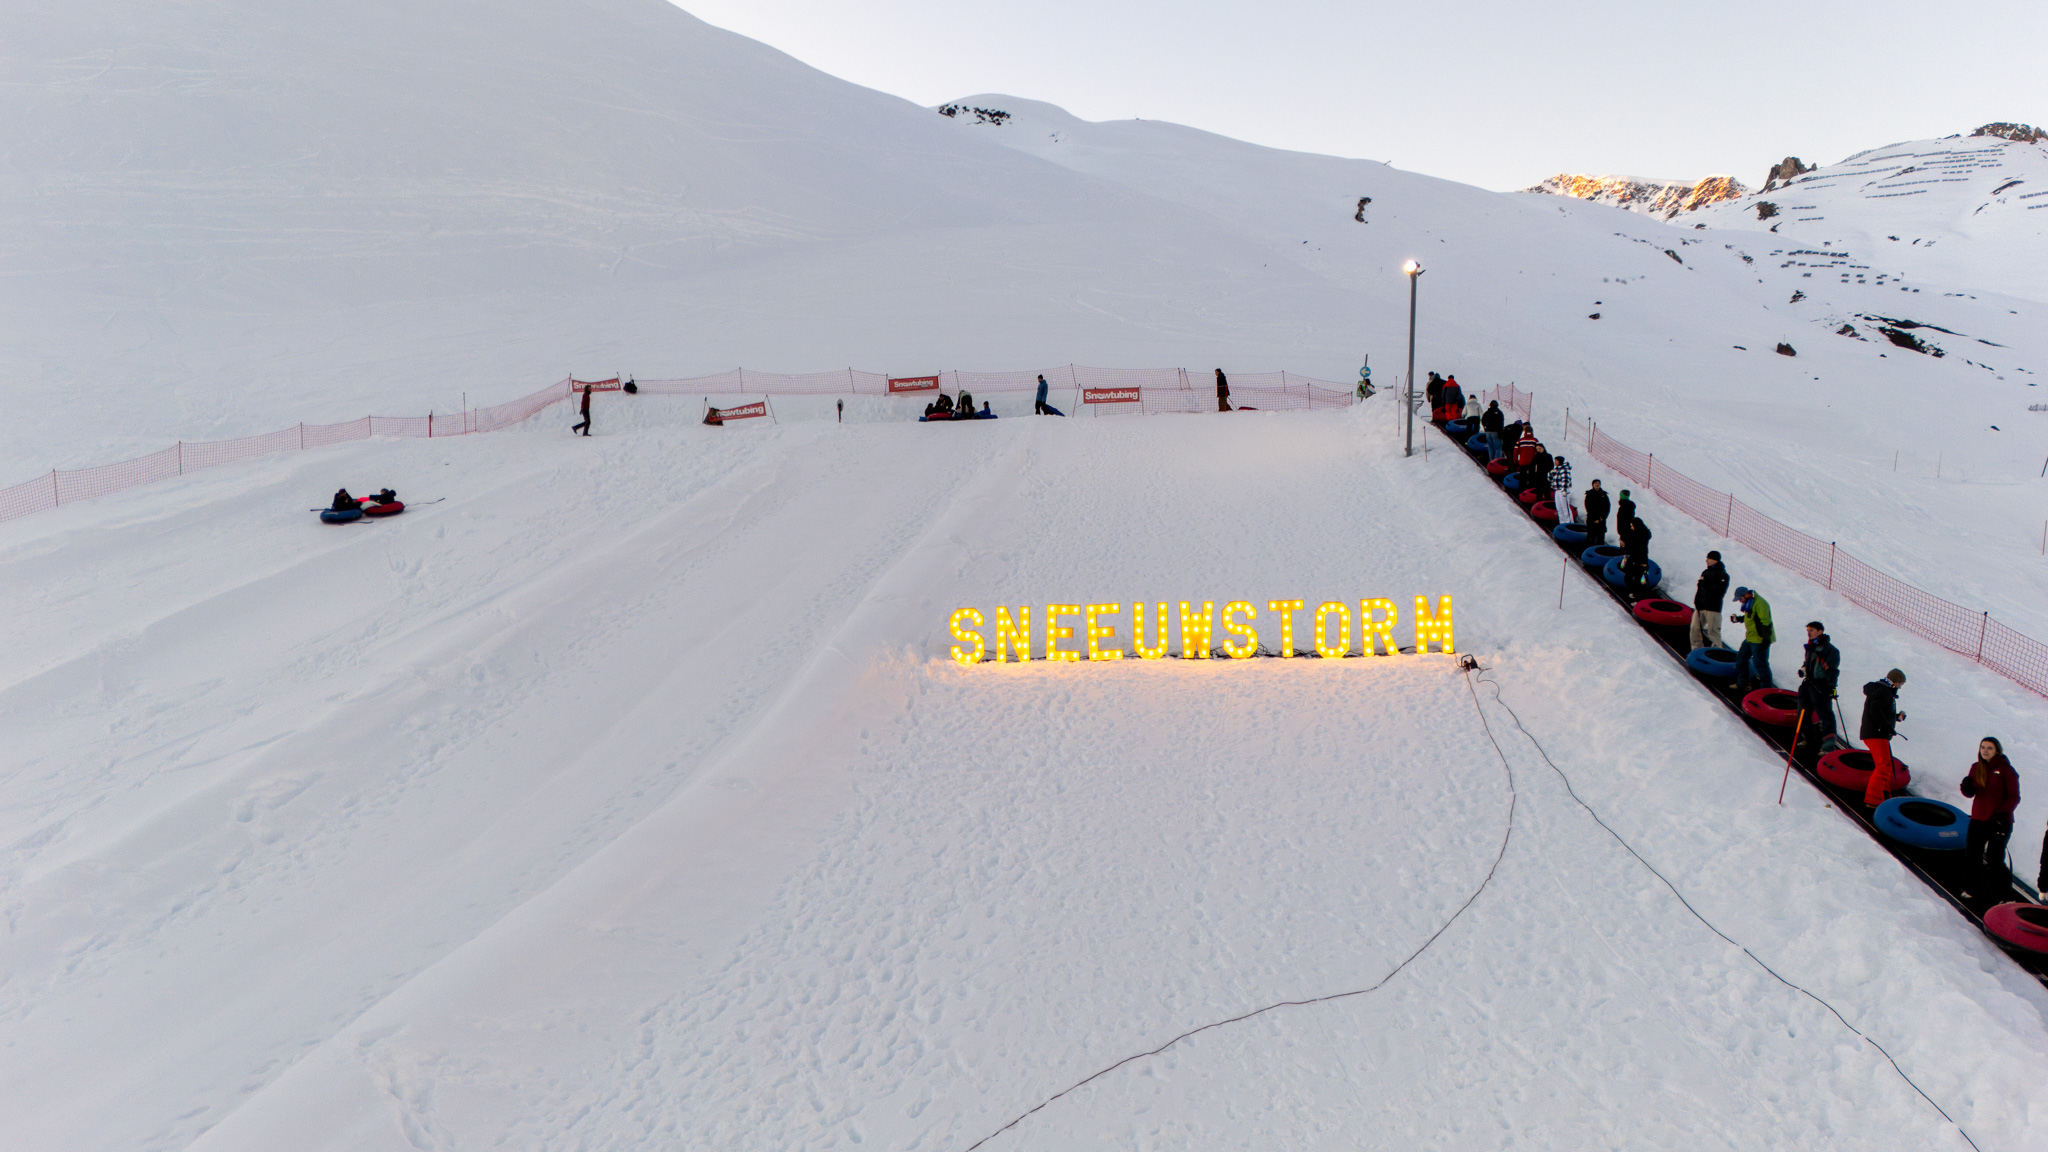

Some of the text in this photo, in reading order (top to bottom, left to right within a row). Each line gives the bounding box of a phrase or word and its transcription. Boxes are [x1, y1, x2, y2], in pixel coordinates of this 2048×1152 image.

[1085, 390, 1139, 400] Snowtubing
[711, 406, 764, 418] nowtubing
[949, 595, 1454, 664] SNEEUWSTORM
